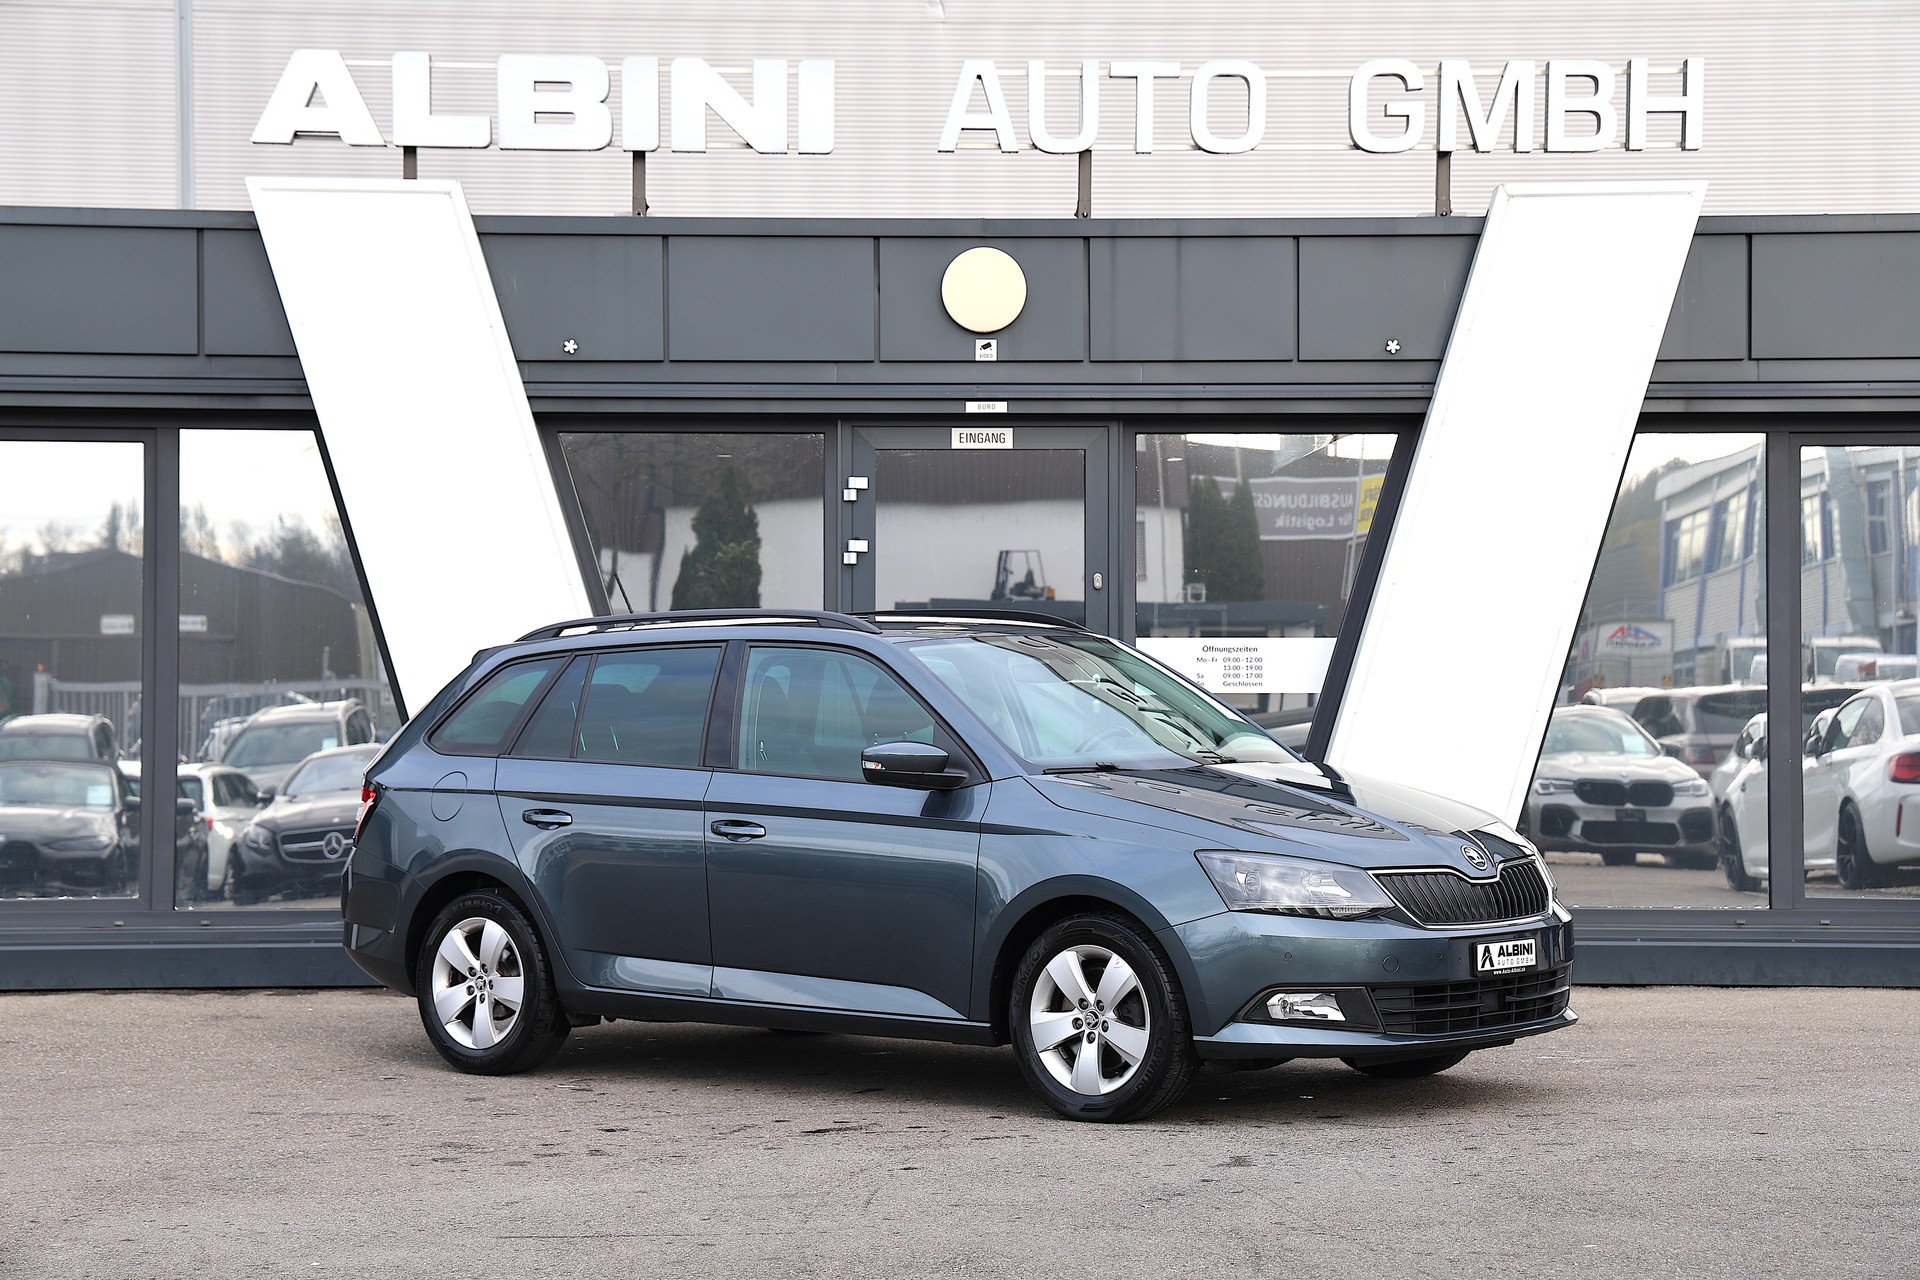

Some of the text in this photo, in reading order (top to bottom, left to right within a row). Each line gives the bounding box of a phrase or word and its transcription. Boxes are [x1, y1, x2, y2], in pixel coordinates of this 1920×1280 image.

[250, 49, 1705, 155] ALBINI AUTO GMBH
[977, 402, 996, 410] BÜRO
[959, 432, 1006, 444] EINGANG
[1202, 644, 1258, 654] Öffnungszeiten
[1497, 942, 1533, 958] ALBINI
[1497, 958, 1514, 966] AUTO
